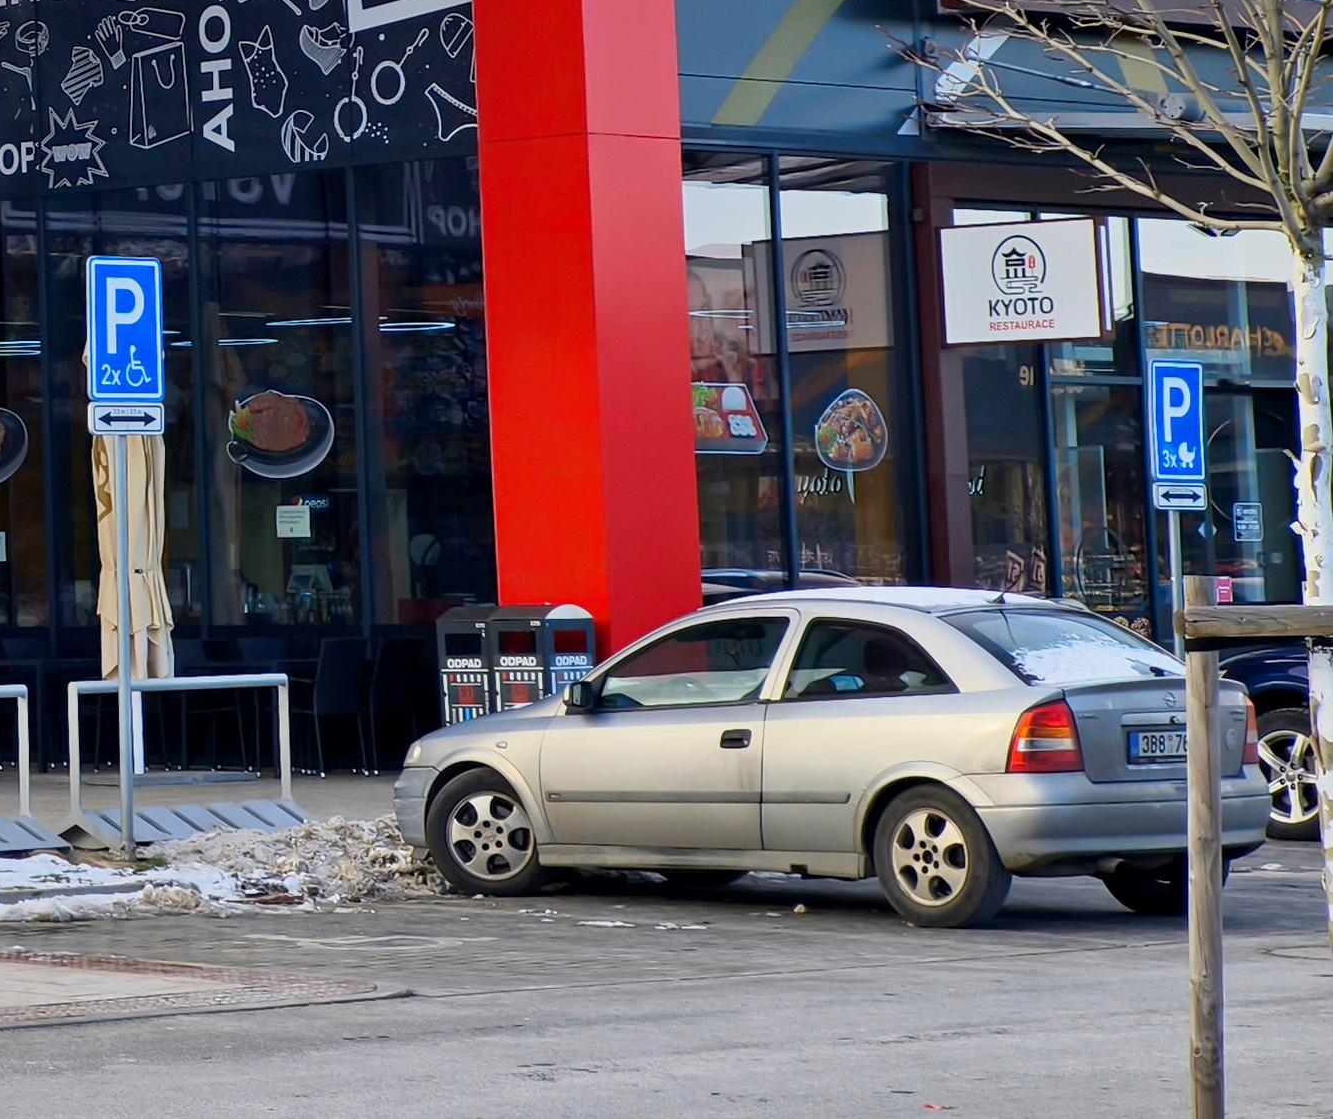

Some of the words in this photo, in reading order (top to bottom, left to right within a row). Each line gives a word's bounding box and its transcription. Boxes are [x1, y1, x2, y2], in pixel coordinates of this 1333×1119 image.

[105, 276, 145, 355] P
[988, 295, 1054, 318] KYOTO
[989, 318, 1055, 331] RESTAURACE
[101, 363, 122, 386] 2x
[1162, 376, 1191, 443] P
[1162, 449, 1178, 469] 3x
[446, 658, 482, 669] ODPAD
[500, 656, 537, 667] ODPAD
[556, 655, 587, 666] ODPAD
[1141, 735, 1166, 754] 3B8
